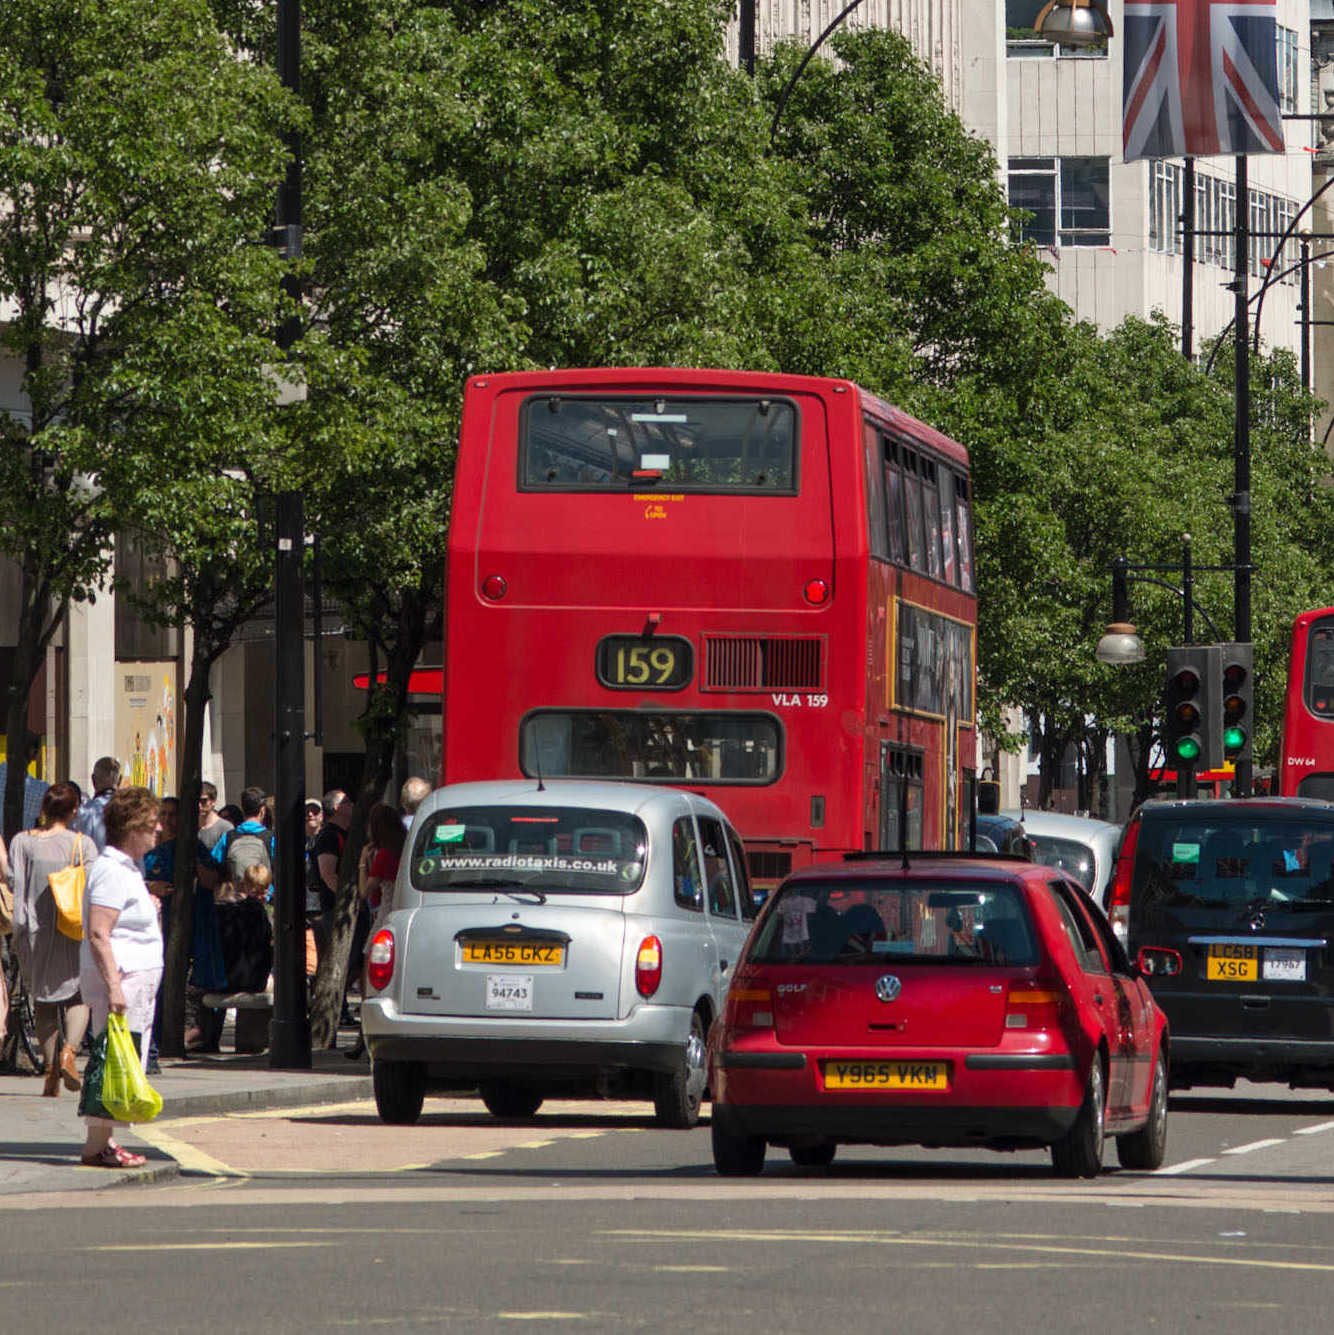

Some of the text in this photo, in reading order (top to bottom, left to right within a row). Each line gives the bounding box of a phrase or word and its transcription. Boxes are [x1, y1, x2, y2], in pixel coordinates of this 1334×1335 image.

[616, 647, 676, 684] 159
[771, 694, 829, 708] VLA 159
[1287, 757, 1316, 766] DW 64
[440, 856, 617, 873] www.radiotaxis.co.uk
[470, 944, 555, 962] LA56 GKZ
[1212, 945, 1254, 959] LC58
[1217, 961, 1248, 977] XSG
[1270, 960, 1301, 970] 17967
[492, 988, 528, 999] 94743
[777, 984, 807, 993] GOLF
[836, 1065, 937, 1085] Y965 VKM
